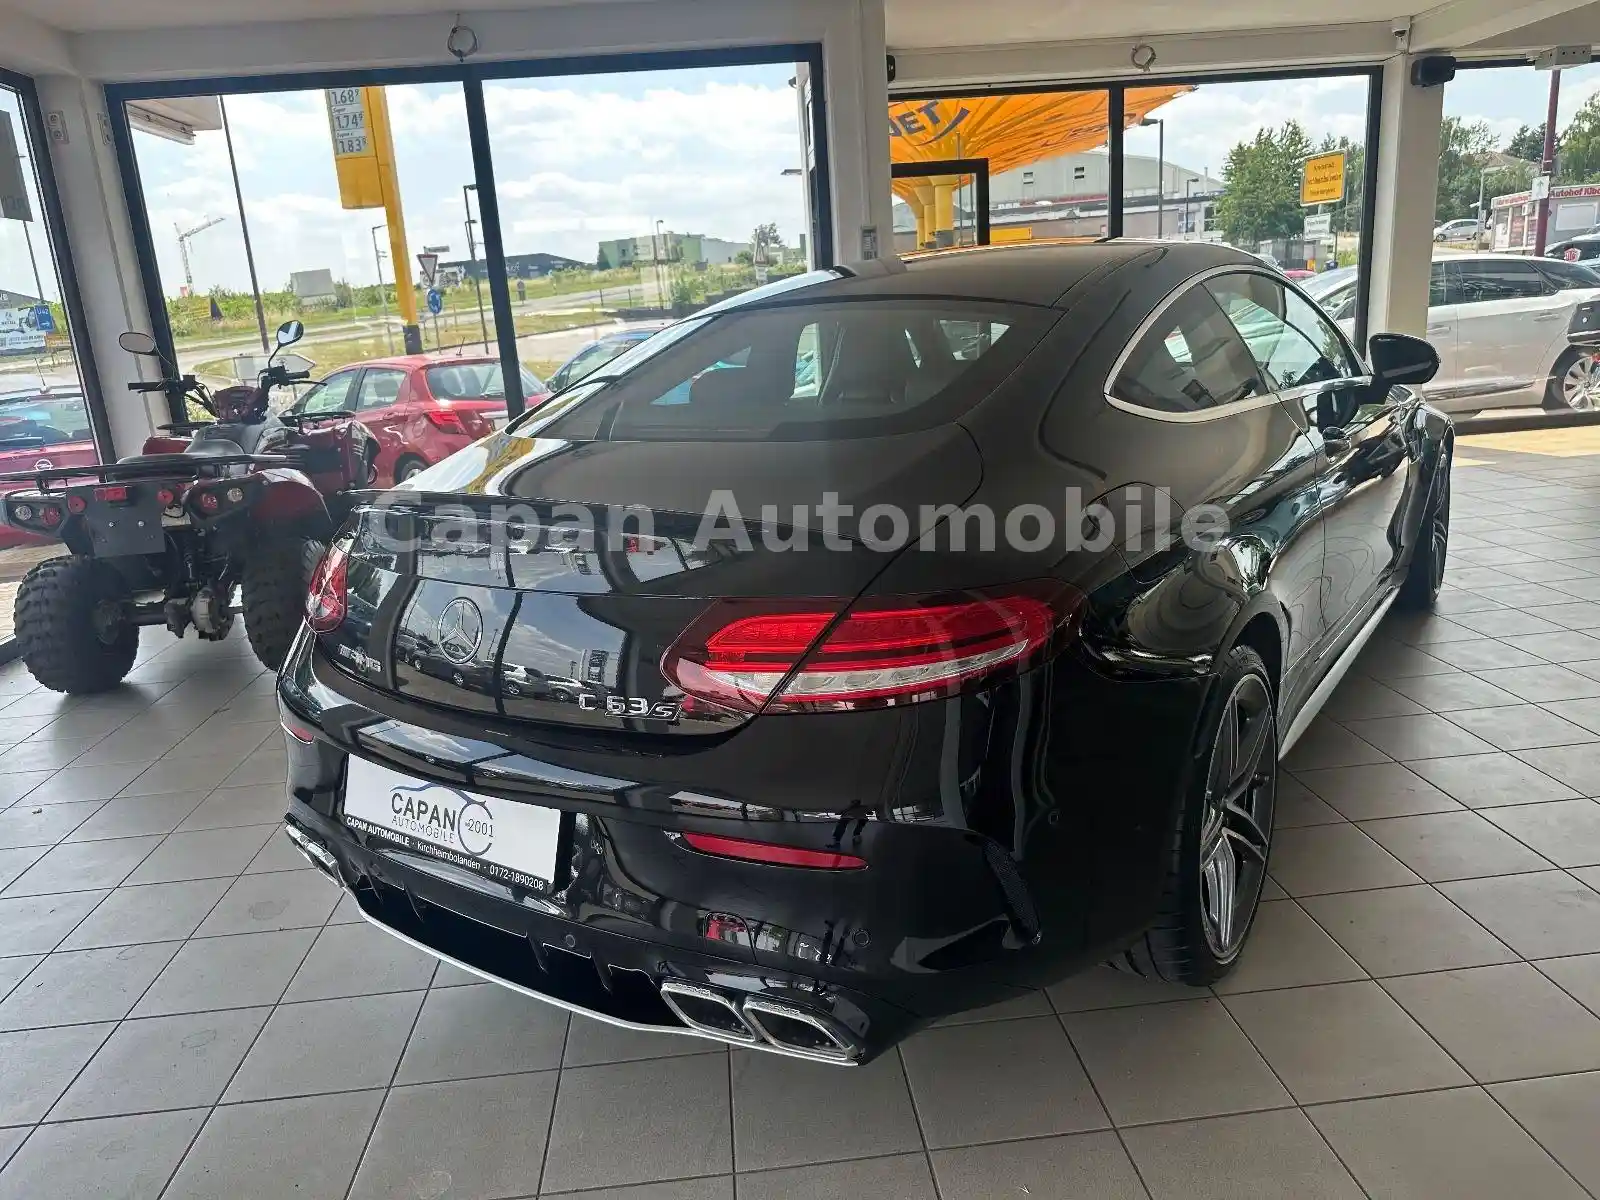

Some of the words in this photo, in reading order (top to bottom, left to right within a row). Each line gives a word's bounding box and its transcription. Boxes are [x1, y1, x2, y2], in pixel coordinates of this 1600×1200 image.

[1550, 187, 1583, 197] Autohof
[578, 693, 598, 711] C
[391, 792, 456, 832] CAPAN
[391, 814, 456, 844] AUTOMOBILE
[467, 818, 494, 838] 2001
[346, 816, 368, 832] CAPAN
[367, 823, 410, 846] AUTOMOBILE
[416, 840, 481, 870] Kirchheimbolanden
[489, 864, 544, 891] 0172-1890208
